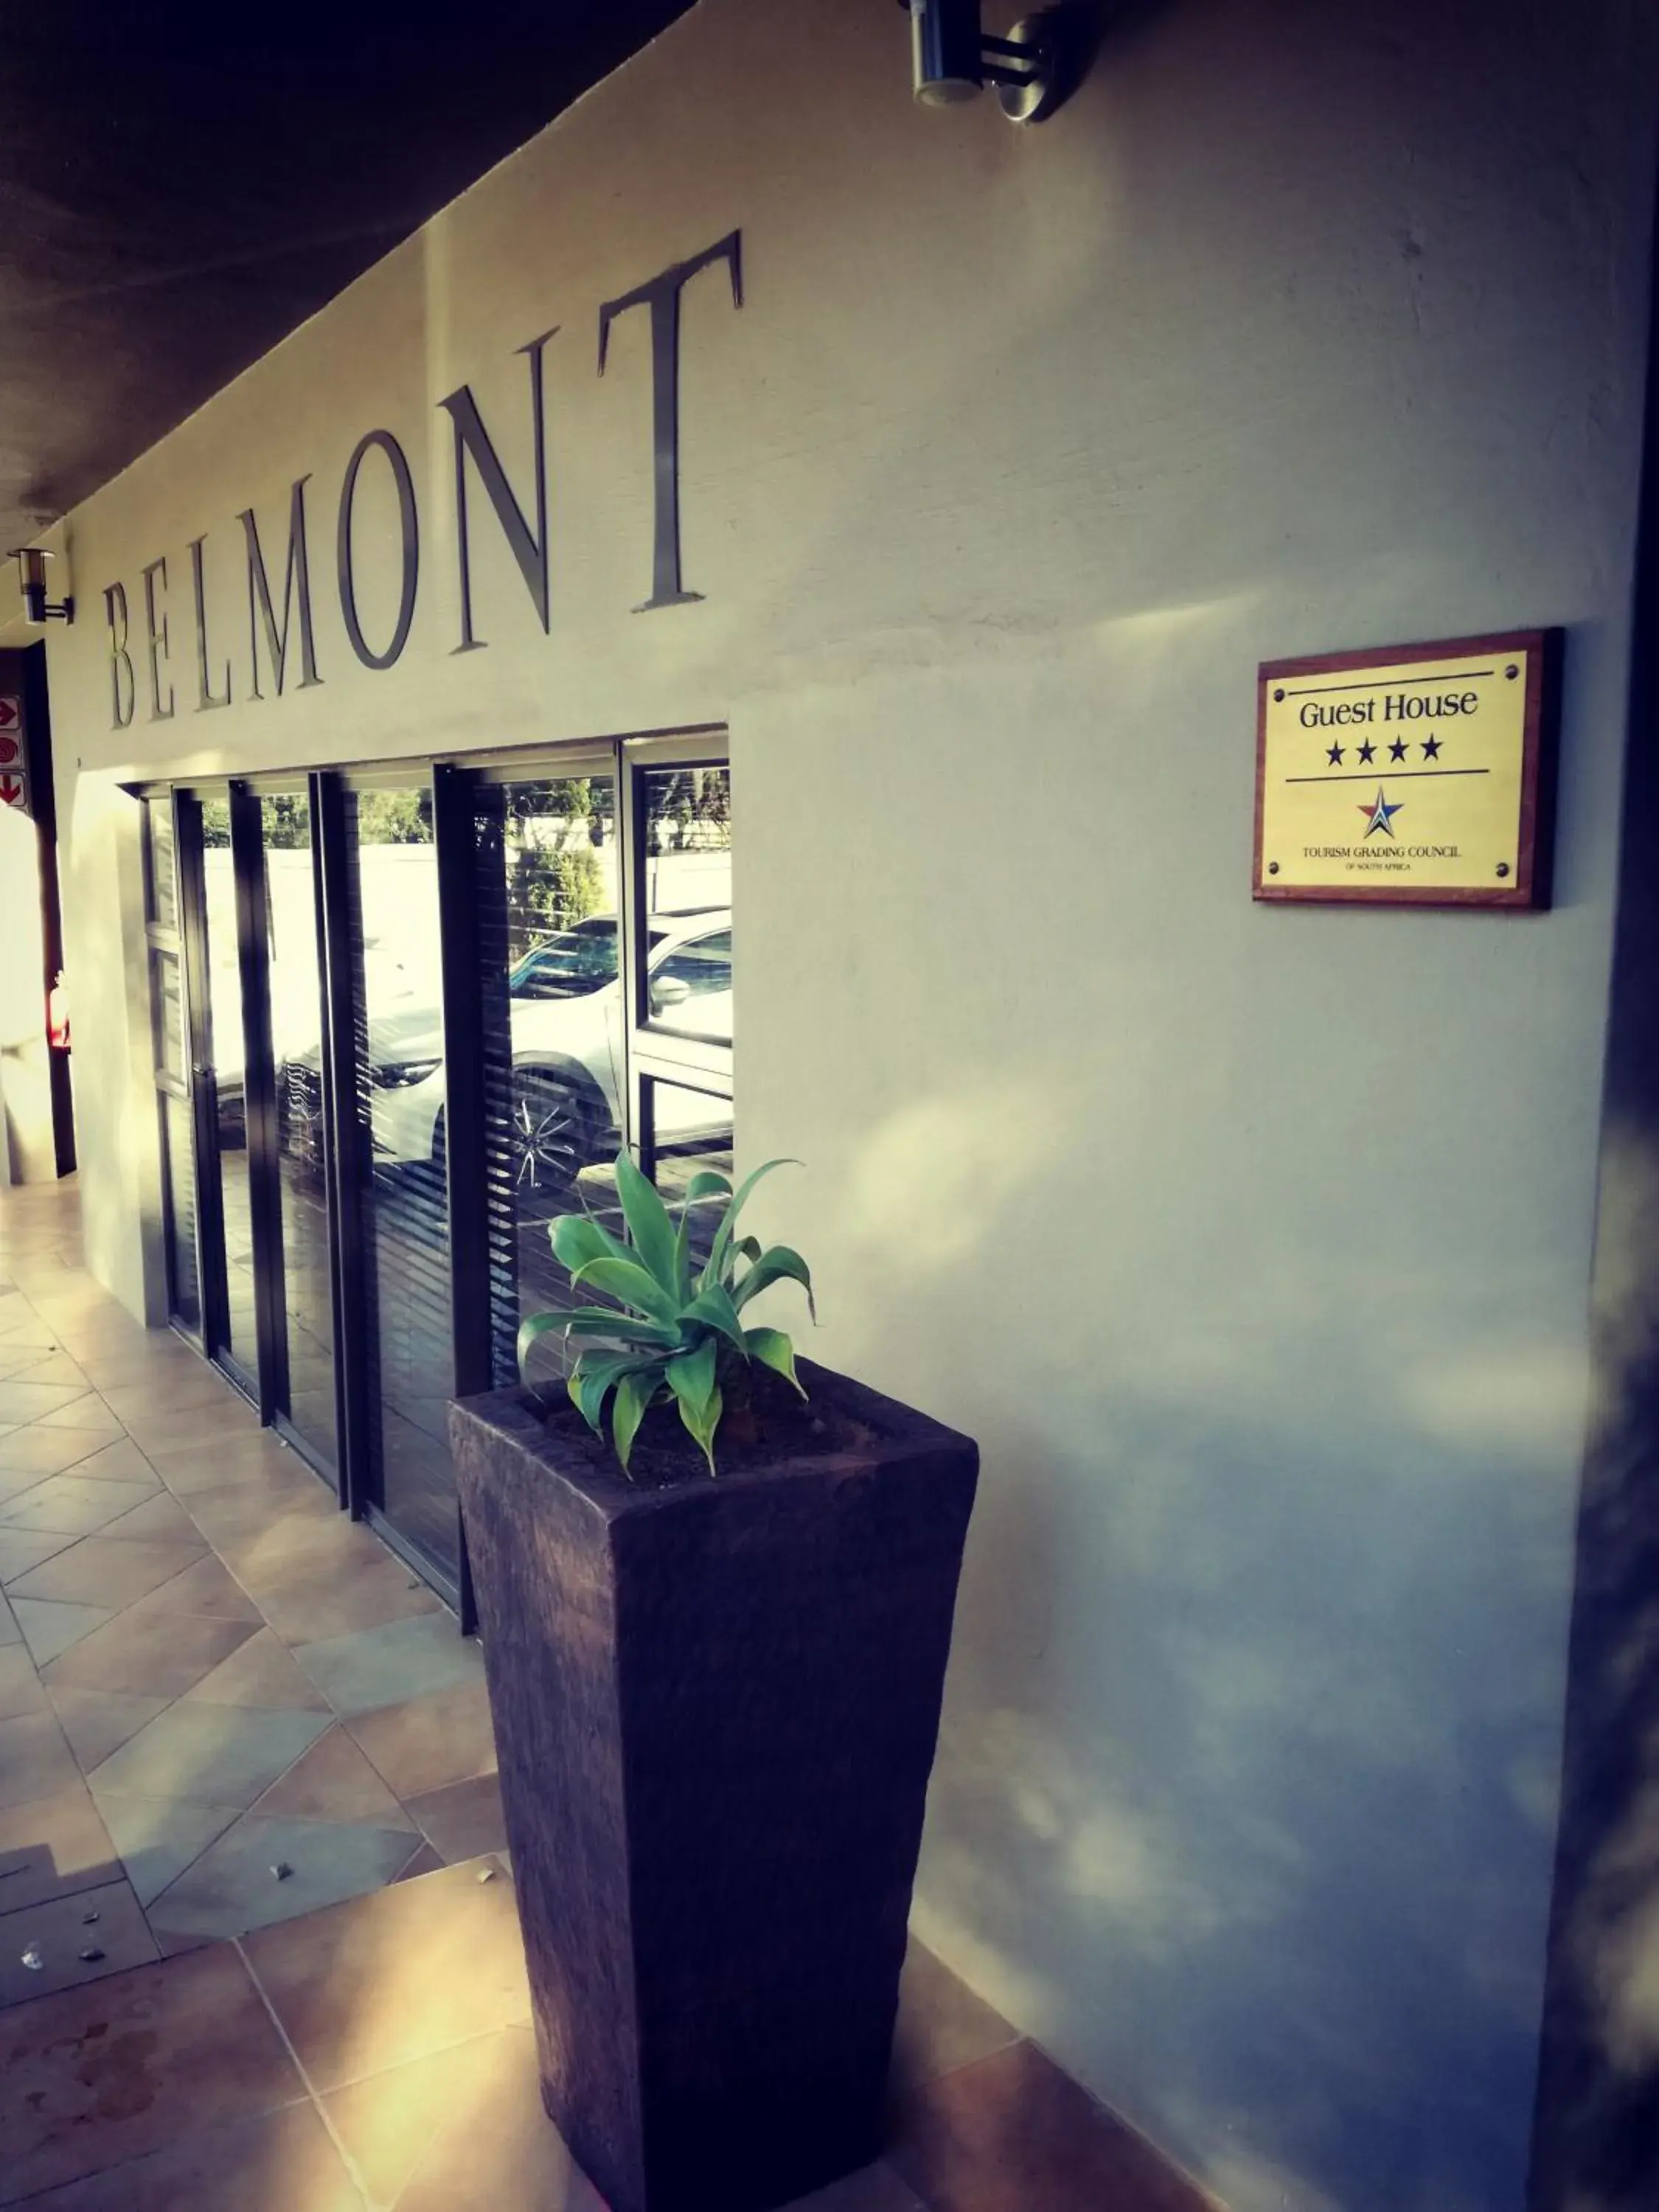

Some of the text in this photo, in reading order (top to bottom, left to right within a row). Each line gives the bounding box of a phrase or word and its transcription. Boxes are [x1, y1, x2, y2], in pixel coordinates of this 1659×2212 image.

[103, 229, 742, 730] BELMONT
[1299, 691, 1478, 728] Guest House
[1303, 846, 1461, 858] TOURISM GRADING COUNCIL
[1345, 863, 1411, 871] OF SOUTH AFRICA
